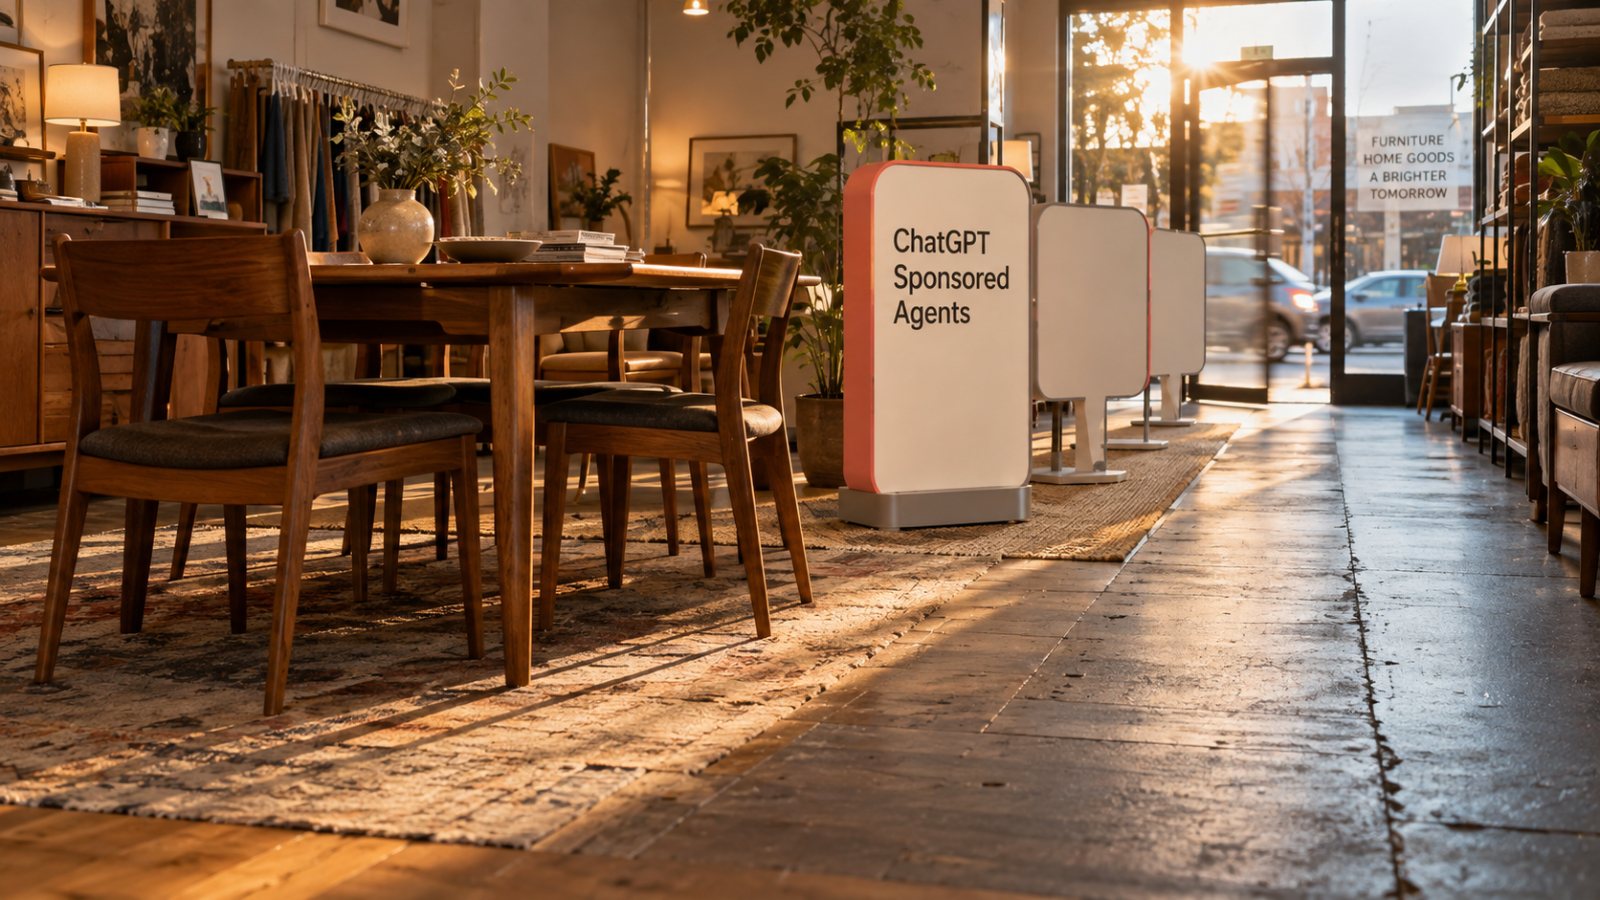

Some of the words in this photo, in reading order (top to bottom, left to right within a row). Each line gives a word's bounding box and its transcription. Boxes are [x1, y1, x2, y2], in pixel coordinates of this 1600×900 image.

[1371, 135, 1444, 147] FURNITURE
[1363, 153, 1402, 165] HOME
[1406, 151, 1455, 164] GOODS
[1369, 171, 1378, 183] A
[1383, 170, 1447, 182] BRIGHTER
[1370, 188, 1448, 199] TOMORROW
[893, 227, 991, 255] ChatGPT
[893, 263, 1010, 296] Sponsored
[893, 299, 971, 331] Agents
